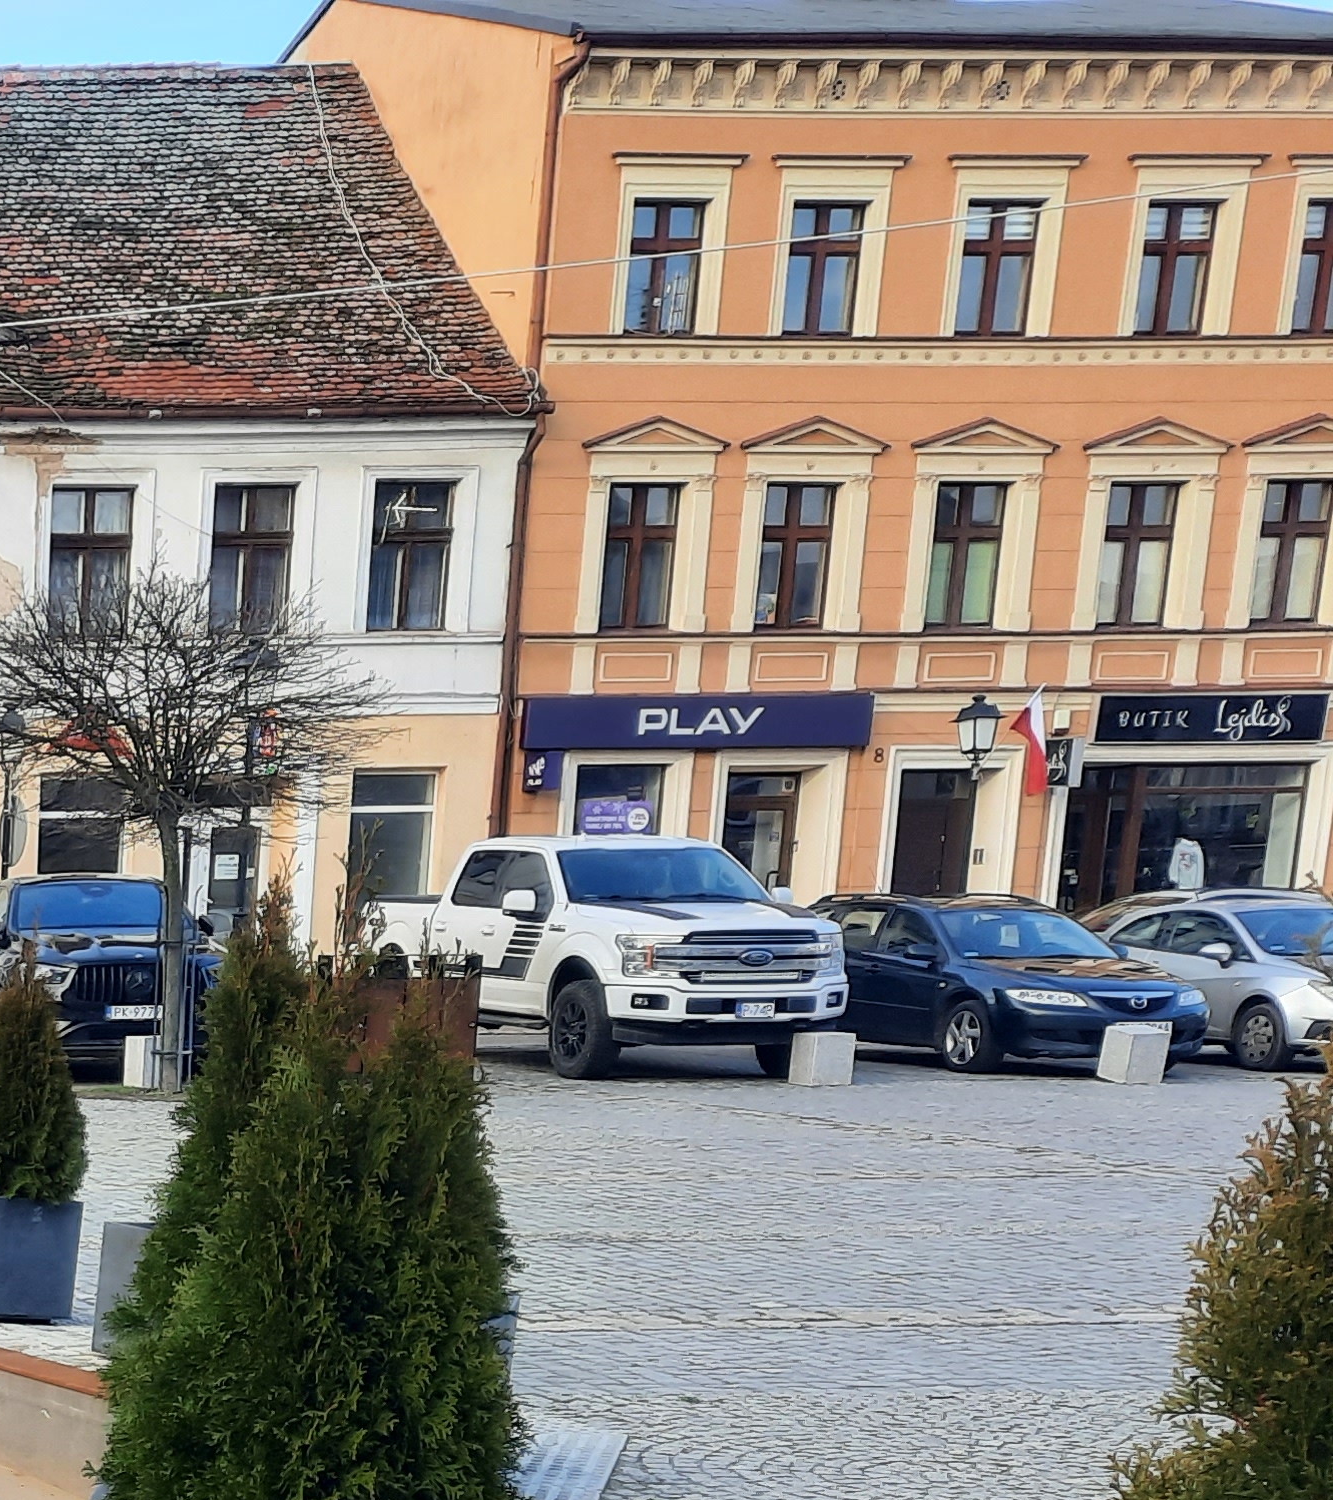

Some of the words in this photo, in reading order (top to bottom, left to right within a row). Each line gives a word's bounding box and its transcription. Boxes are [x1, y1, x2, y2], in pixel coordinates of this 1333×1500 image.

[637, 706, 765, 735] PLAY
[1118, 710, 1190, 728] BUTIK
[874, 747, 884, 763] 8
[114, 1007, 129, 1017] PK
